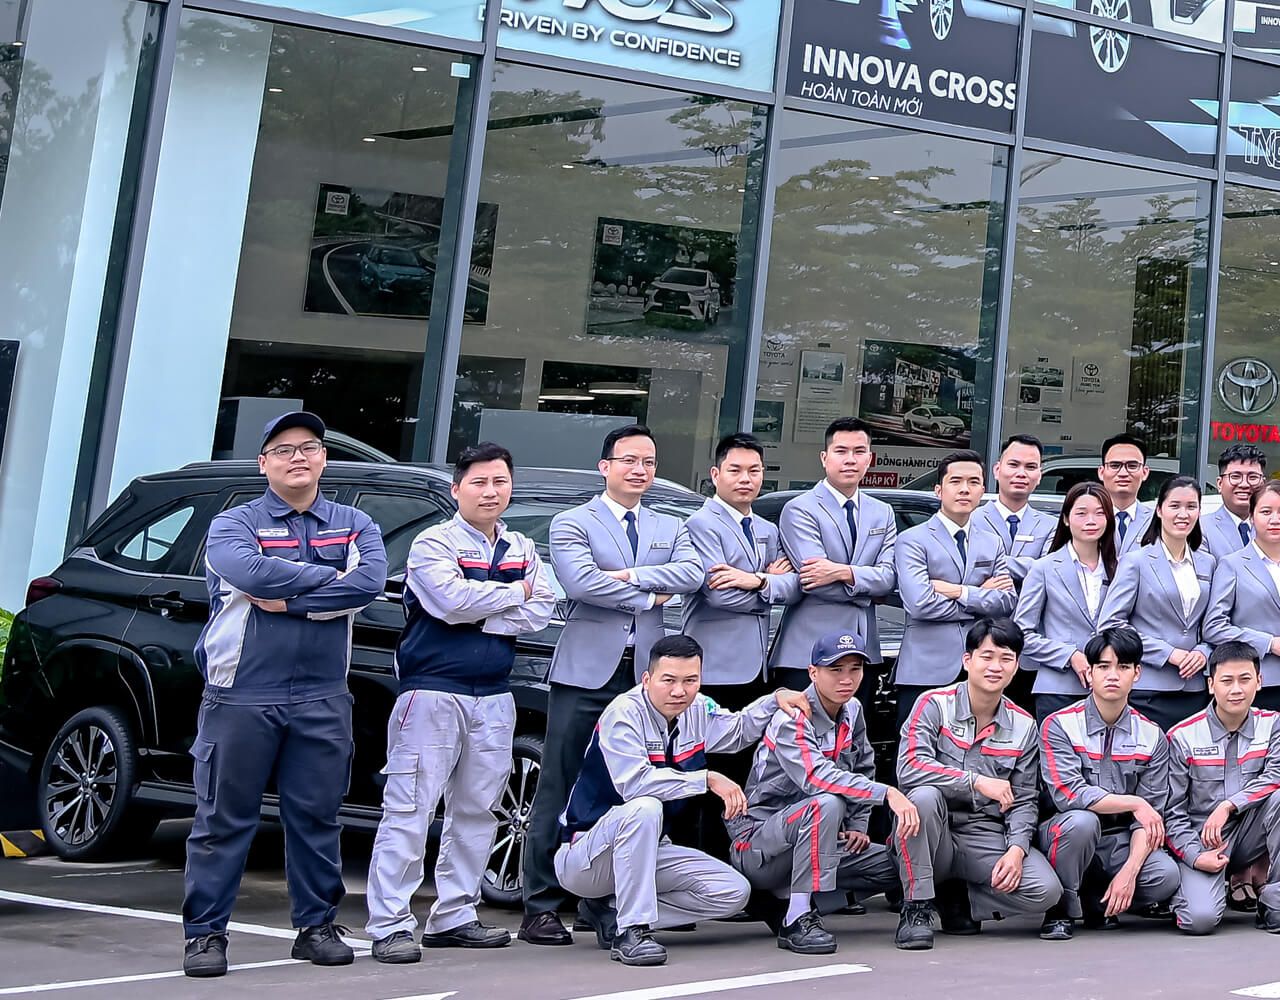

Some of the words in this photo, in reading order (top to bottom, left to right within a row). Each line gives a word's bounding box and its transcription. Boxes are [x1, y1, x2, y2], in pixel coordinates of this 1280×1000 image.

[572, 21, 606, 42] BY
[610, 30, 741, 68] CONFIDENCE
[802, 43, 923, 93] INNOVA
[928, 69, 1017, 111] CROSS
[801, 81, 848, 103] HOÀN
[851, 89, 892, 111] TOÀN
[893, 96, 923, 116] MỚI
[1211, 421, 1280, 443] TOYOTA
[876, 453, 903, 467] ĐỒNG
[903, 454, 926, 468] HÀNH
[926, 456, 941, 469] CÙ
